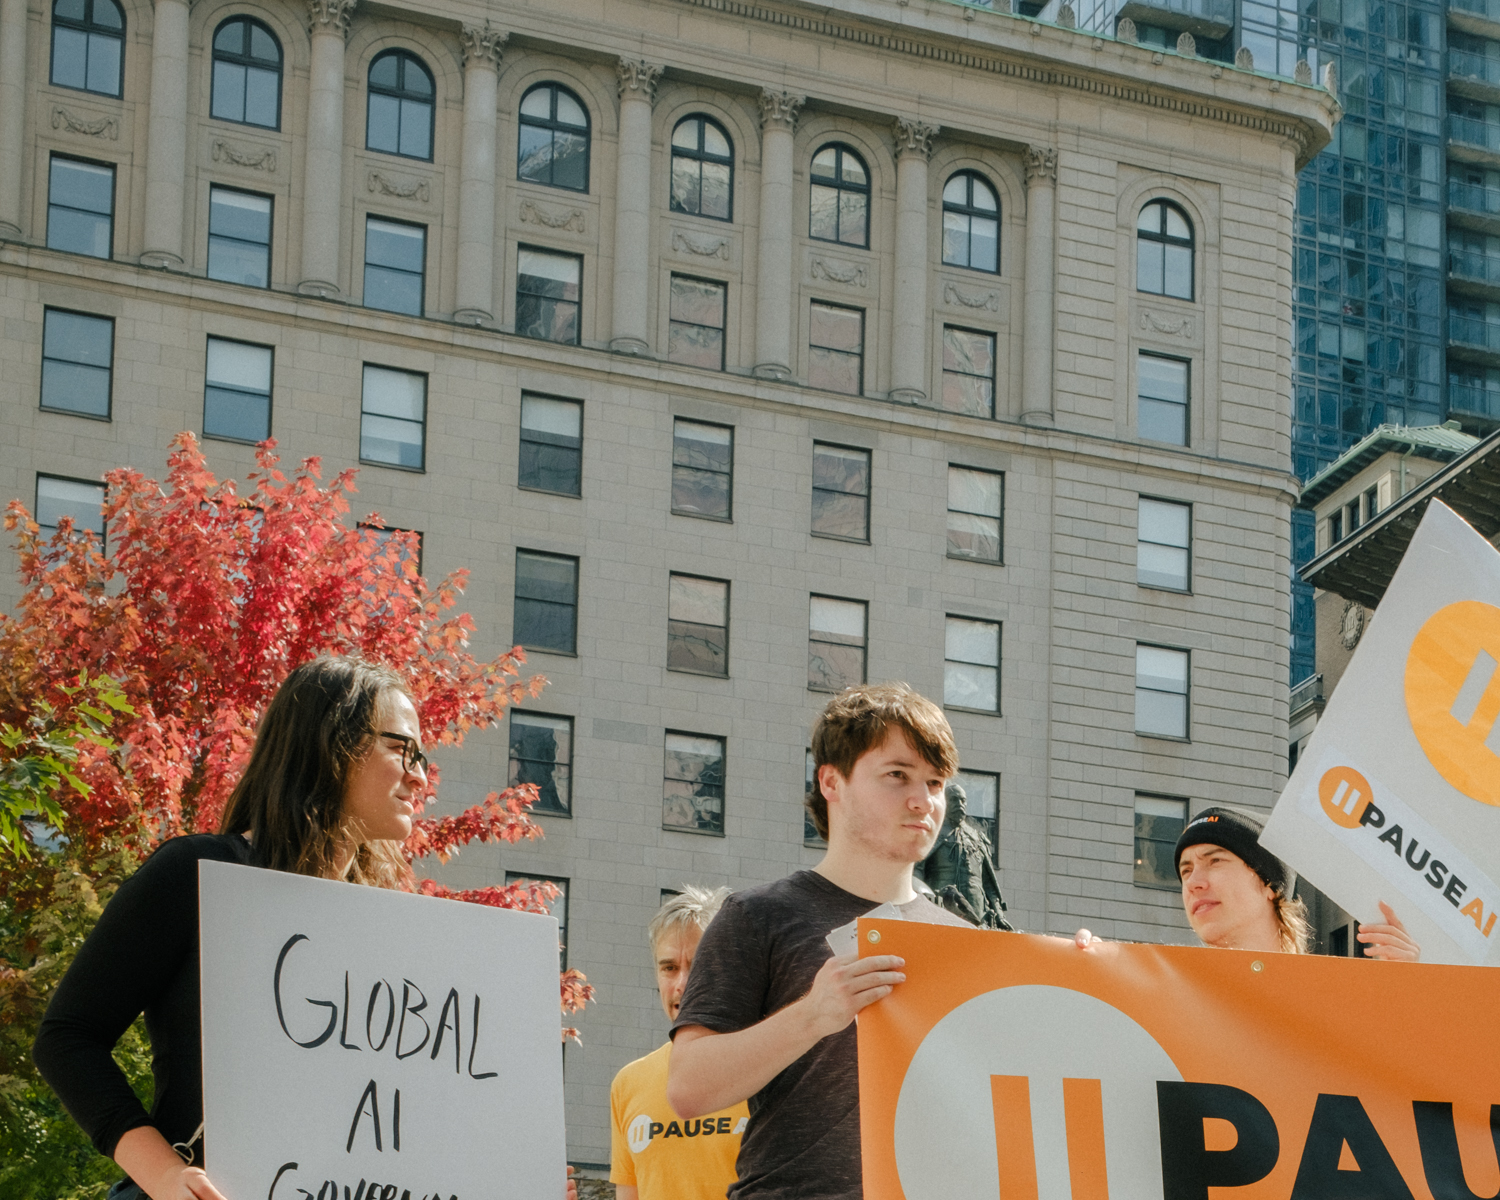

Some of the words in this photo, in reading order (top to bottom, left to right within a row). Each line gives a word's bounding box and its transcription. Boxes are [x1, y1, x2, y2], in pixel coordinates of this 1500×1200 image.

[1359, 802, 1498, 938] PAUSEAI
[273, 934, 498, 1080] GLOBAL
[346, 1079, 400, 1153] AI
